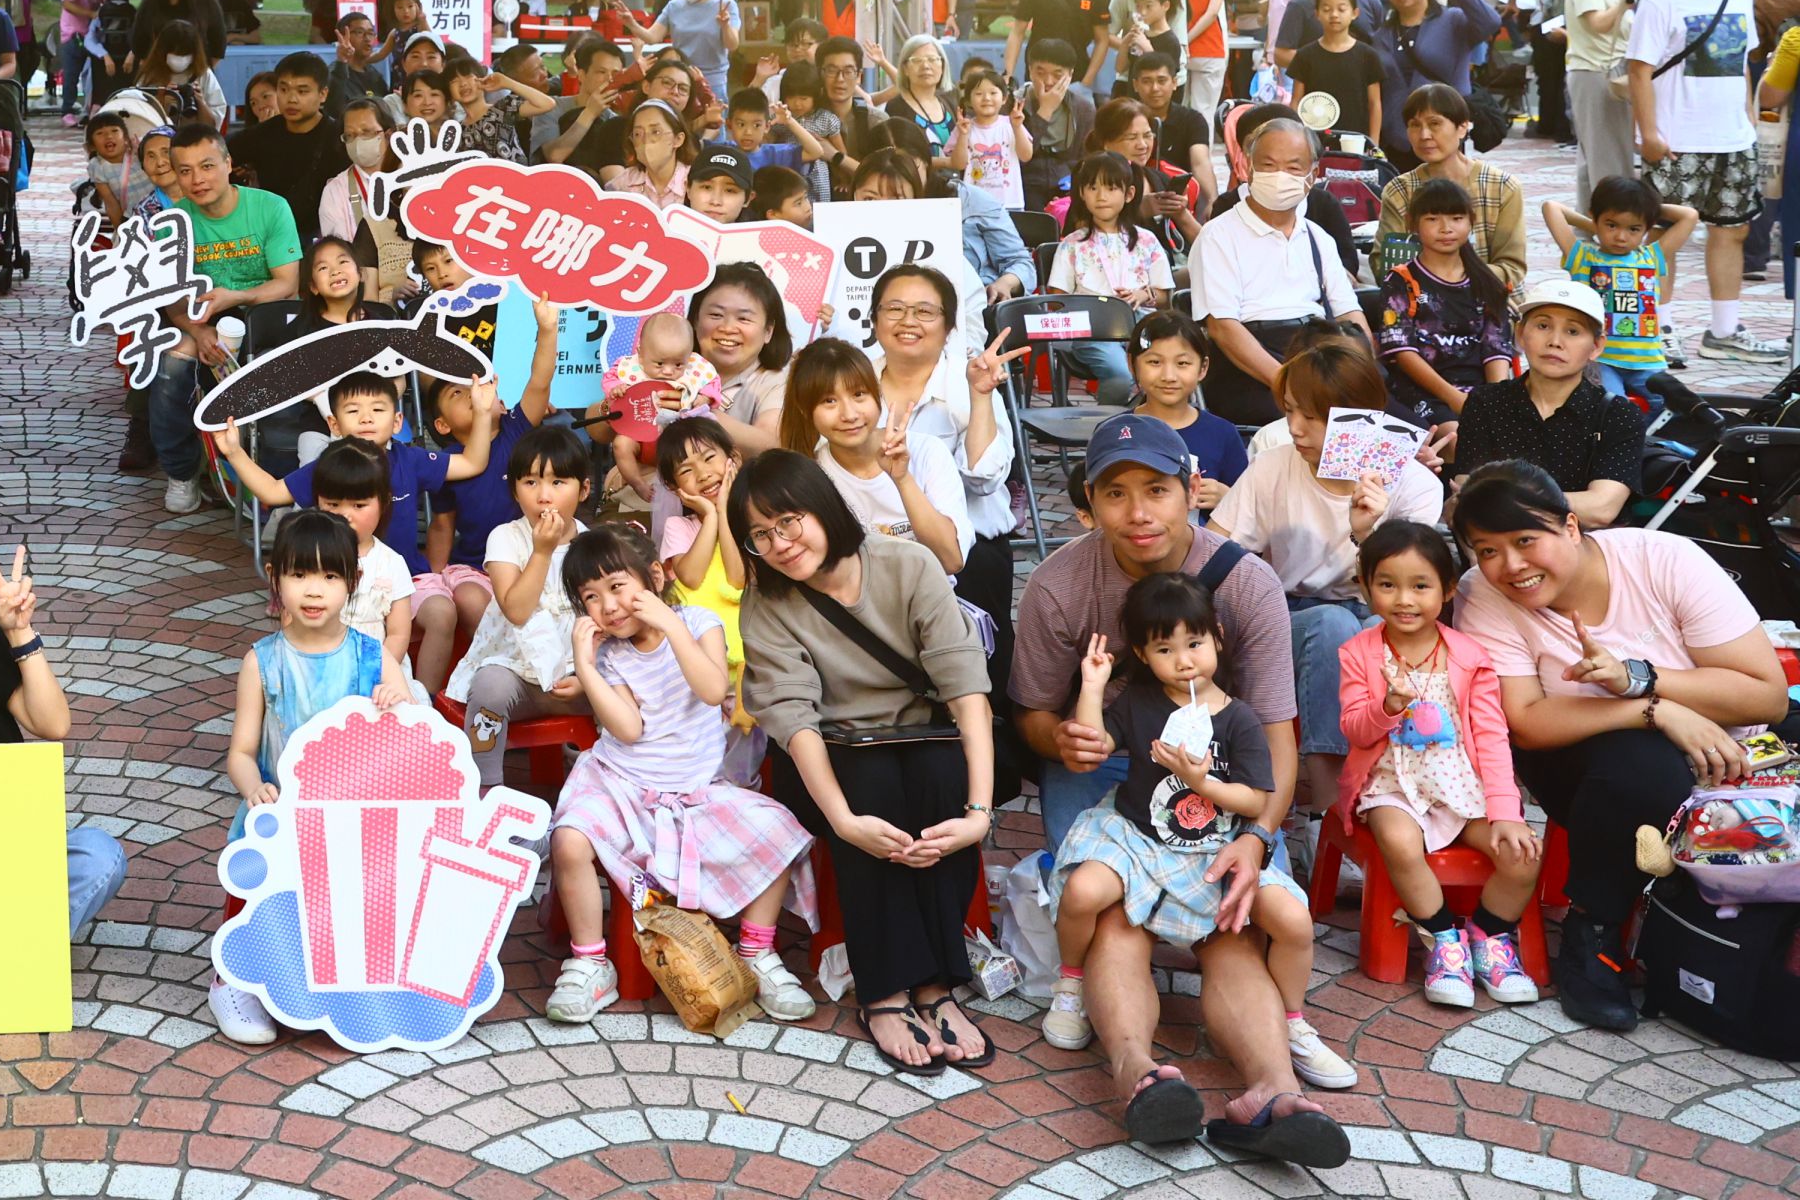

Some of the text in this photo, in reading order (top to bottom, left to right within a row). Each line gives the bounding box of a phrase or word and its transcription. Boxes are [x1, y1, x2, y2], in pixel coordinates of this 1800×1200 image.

[432, 11, 471, 30] 方向
[452, 185, 668, 302] 在哪力
[76, 213, 208, 385] 學
[1615, 297, 1638, 312] 1/2
[1041, 317, 1072, 328] 保留席
